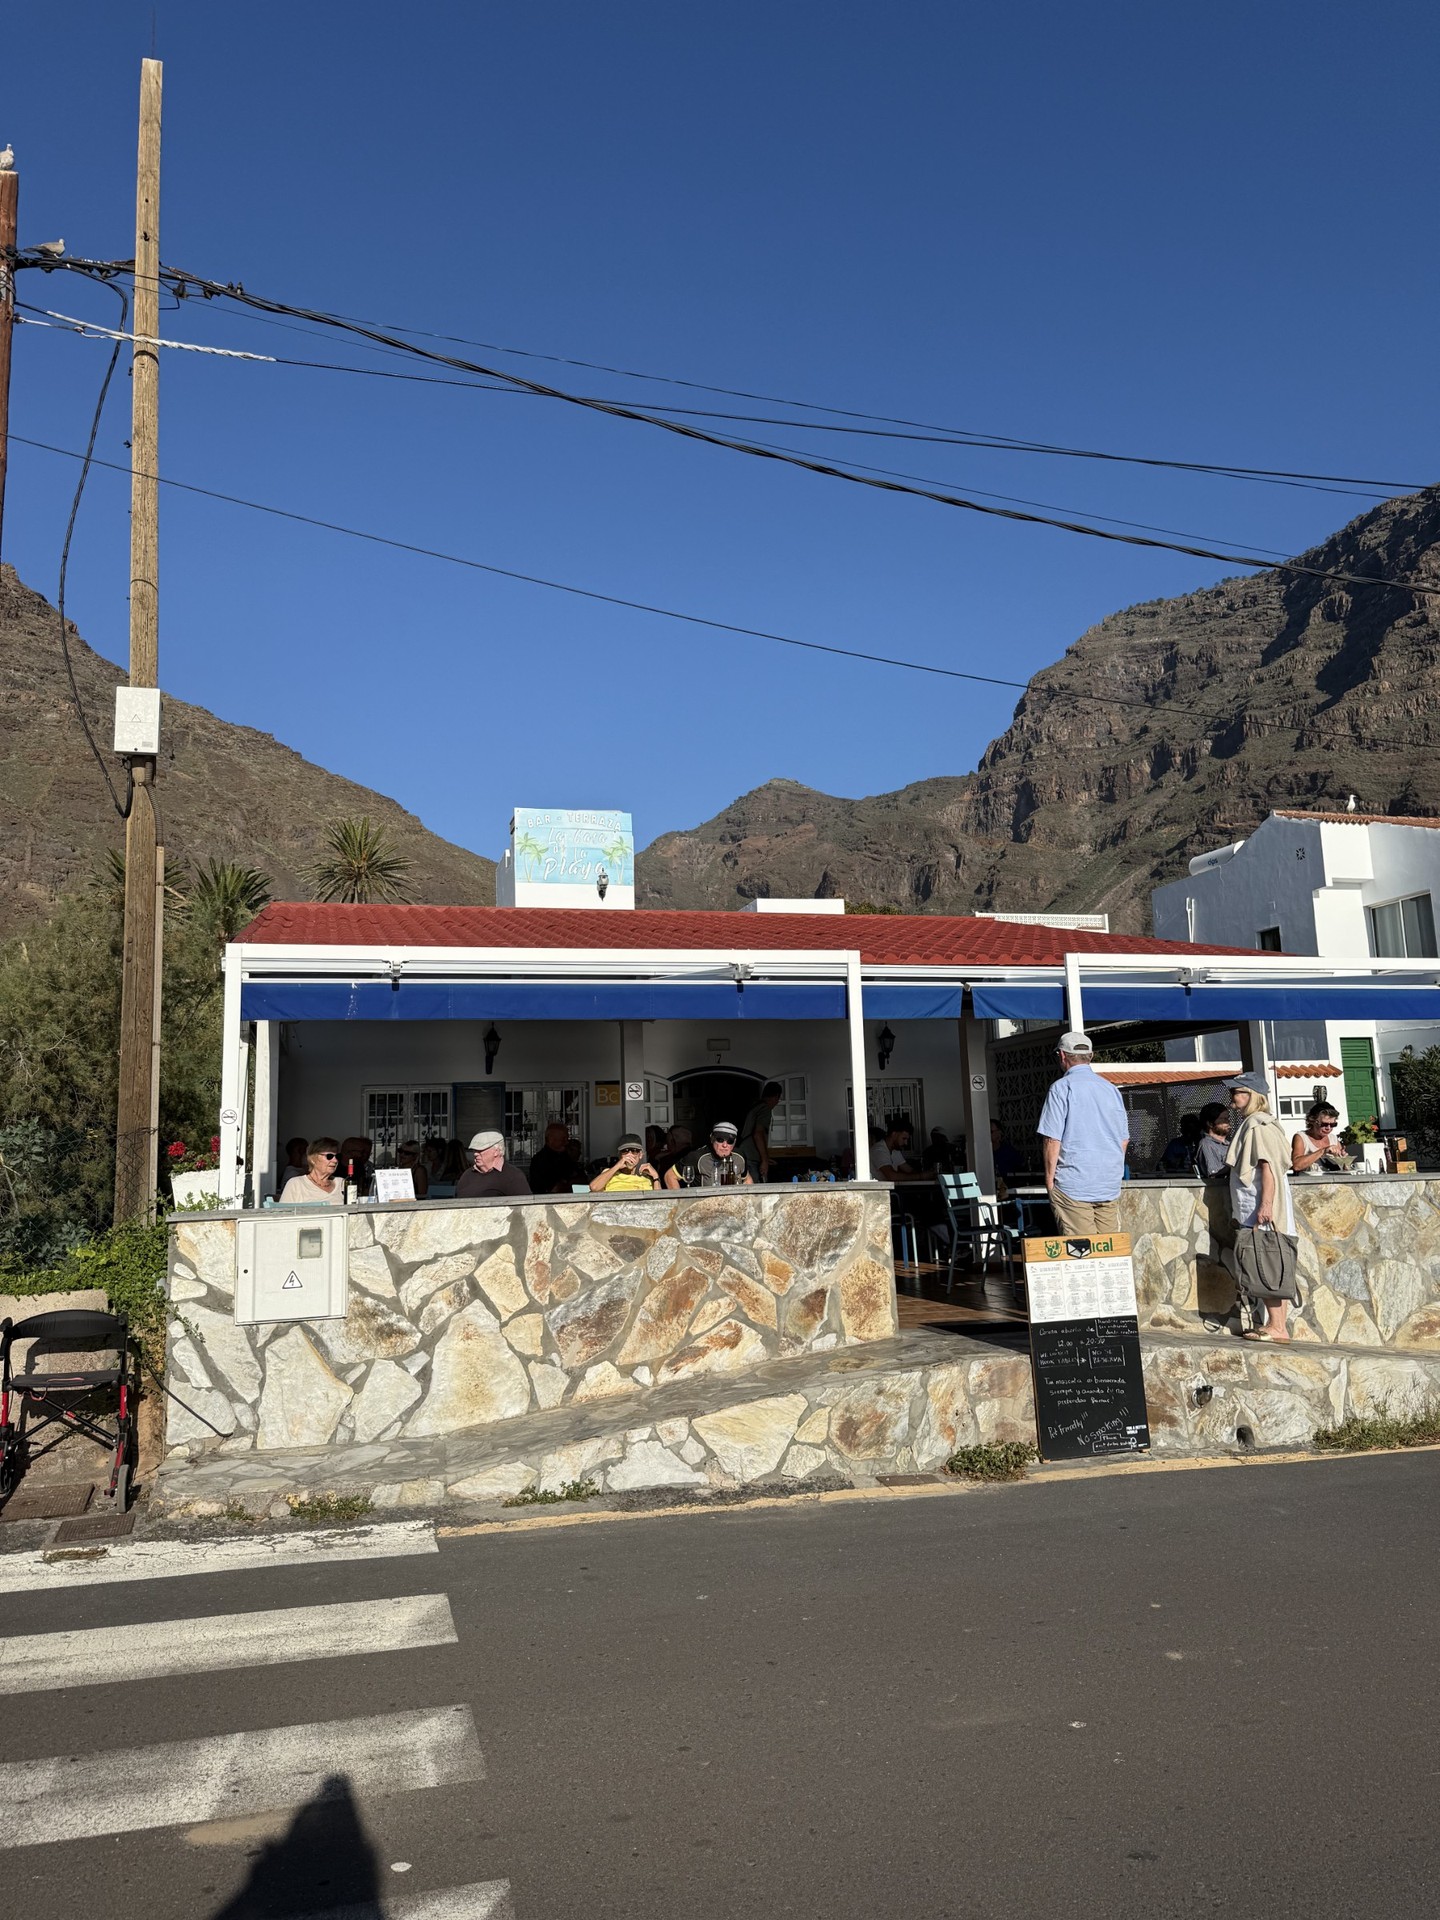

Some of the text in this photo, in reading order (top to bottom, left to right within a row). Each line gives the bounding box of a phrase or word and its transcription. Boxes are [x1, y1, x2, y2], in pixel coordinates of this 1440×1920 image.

[527, 814, 551, 828] BAR
[567, 812, 621, 831] TERRAZA
[716, 1053, 722, 1064] 7
[597, 1087, 618, 1103] Bc
